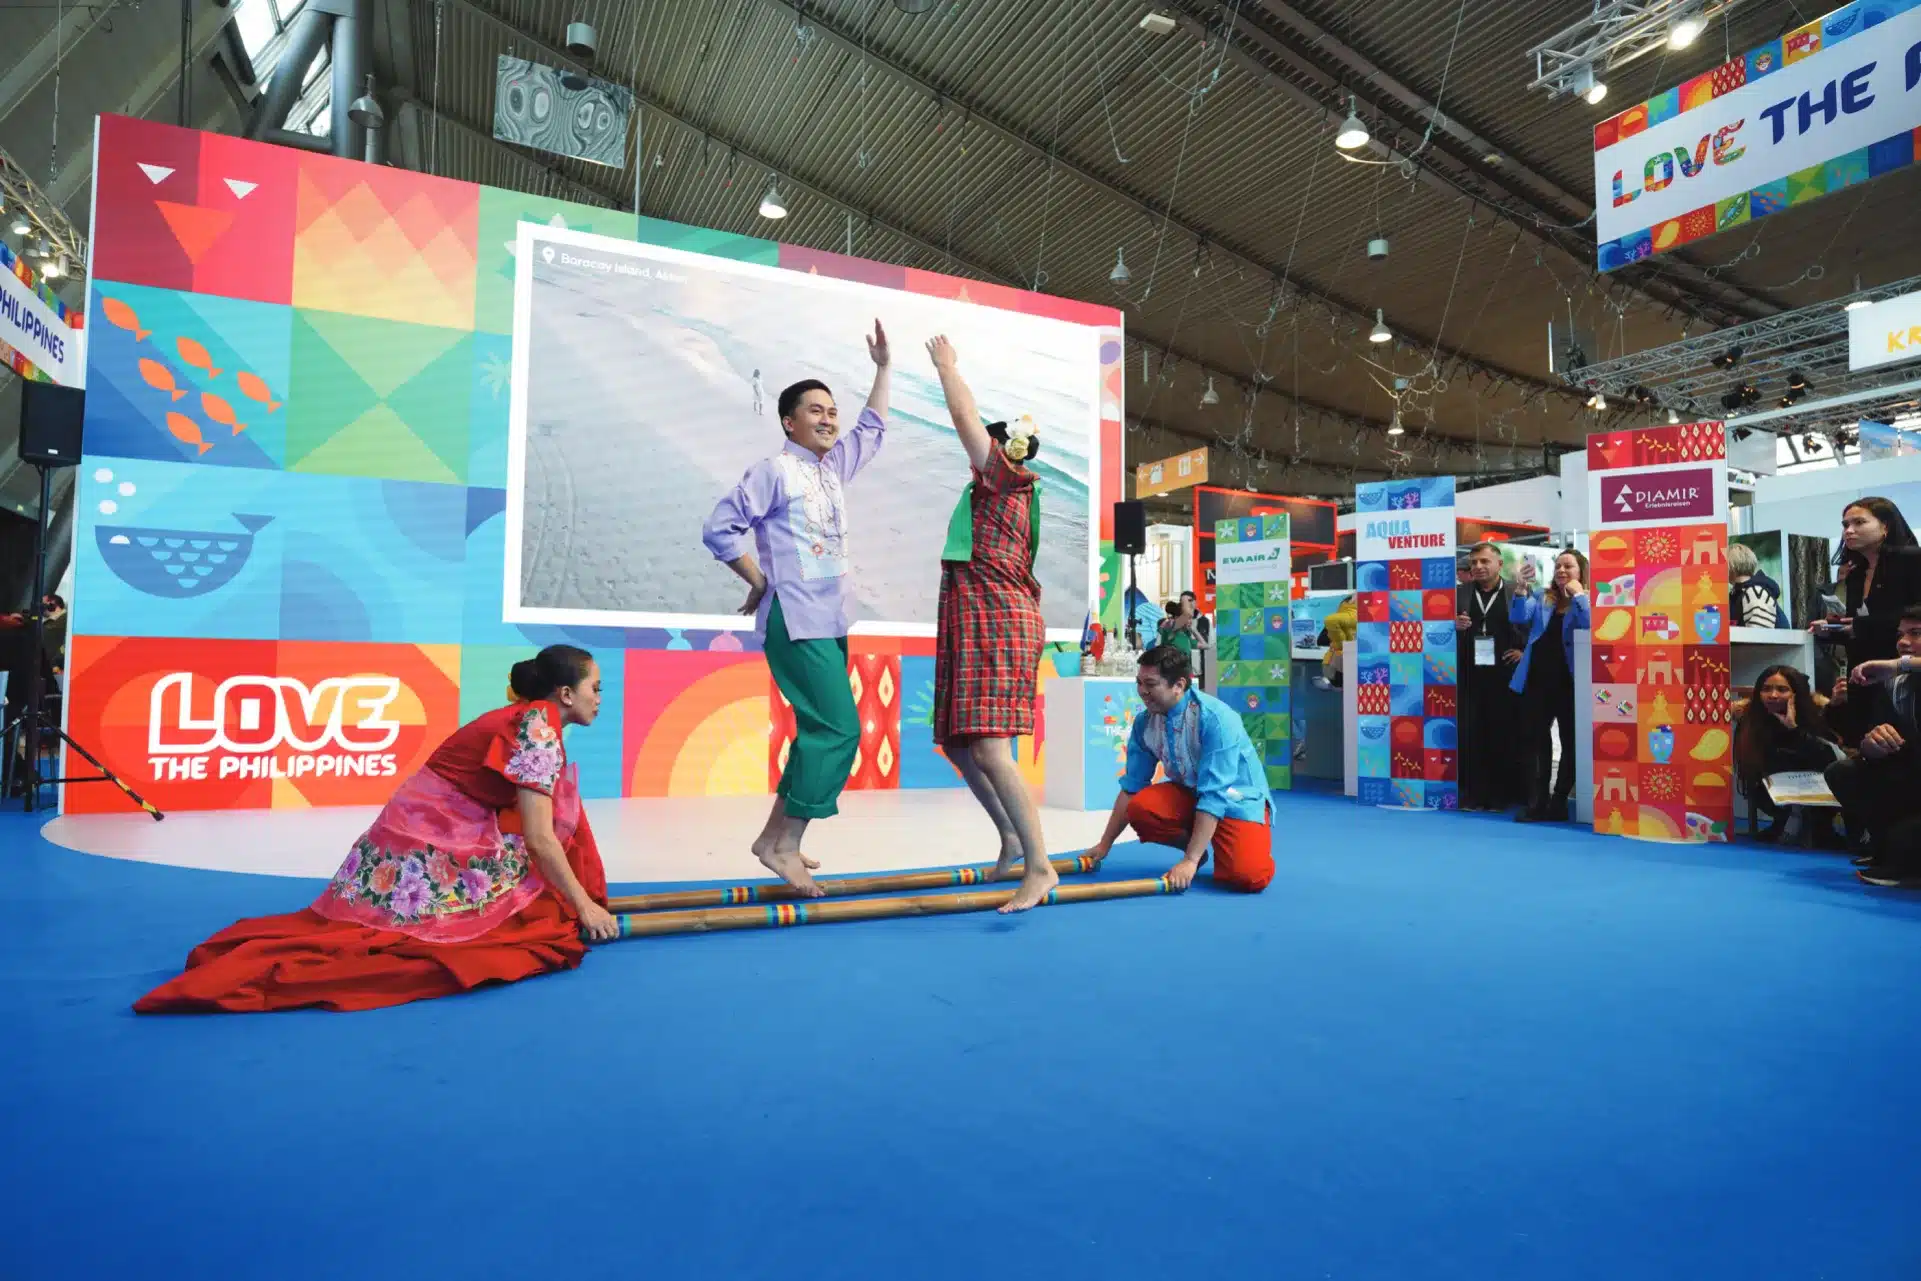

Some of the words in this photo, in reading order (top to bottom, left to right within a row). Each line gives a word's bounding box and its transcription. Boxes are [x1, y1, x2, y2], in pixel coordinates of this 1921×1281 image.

[1612, 118, 1747, 208] LOVE
[1759, 61, 1878, 145] THE
[1636, 487, 1699, 503] DIAMIR
[1645, 501, 1690, 509] Erlebnisreisen
[1366, 519, 1412, 539] AQUA
[1388, 533, 1446, 549] VENTURE
[1222, 555, 1245, 565] EVA
[1246, 553, 1266, 562] AIR
[148, 672, 400, 754] LOVE
[148, 756, 210, 781] THE
[219, 754, 397, 780] PHILIPPINES
